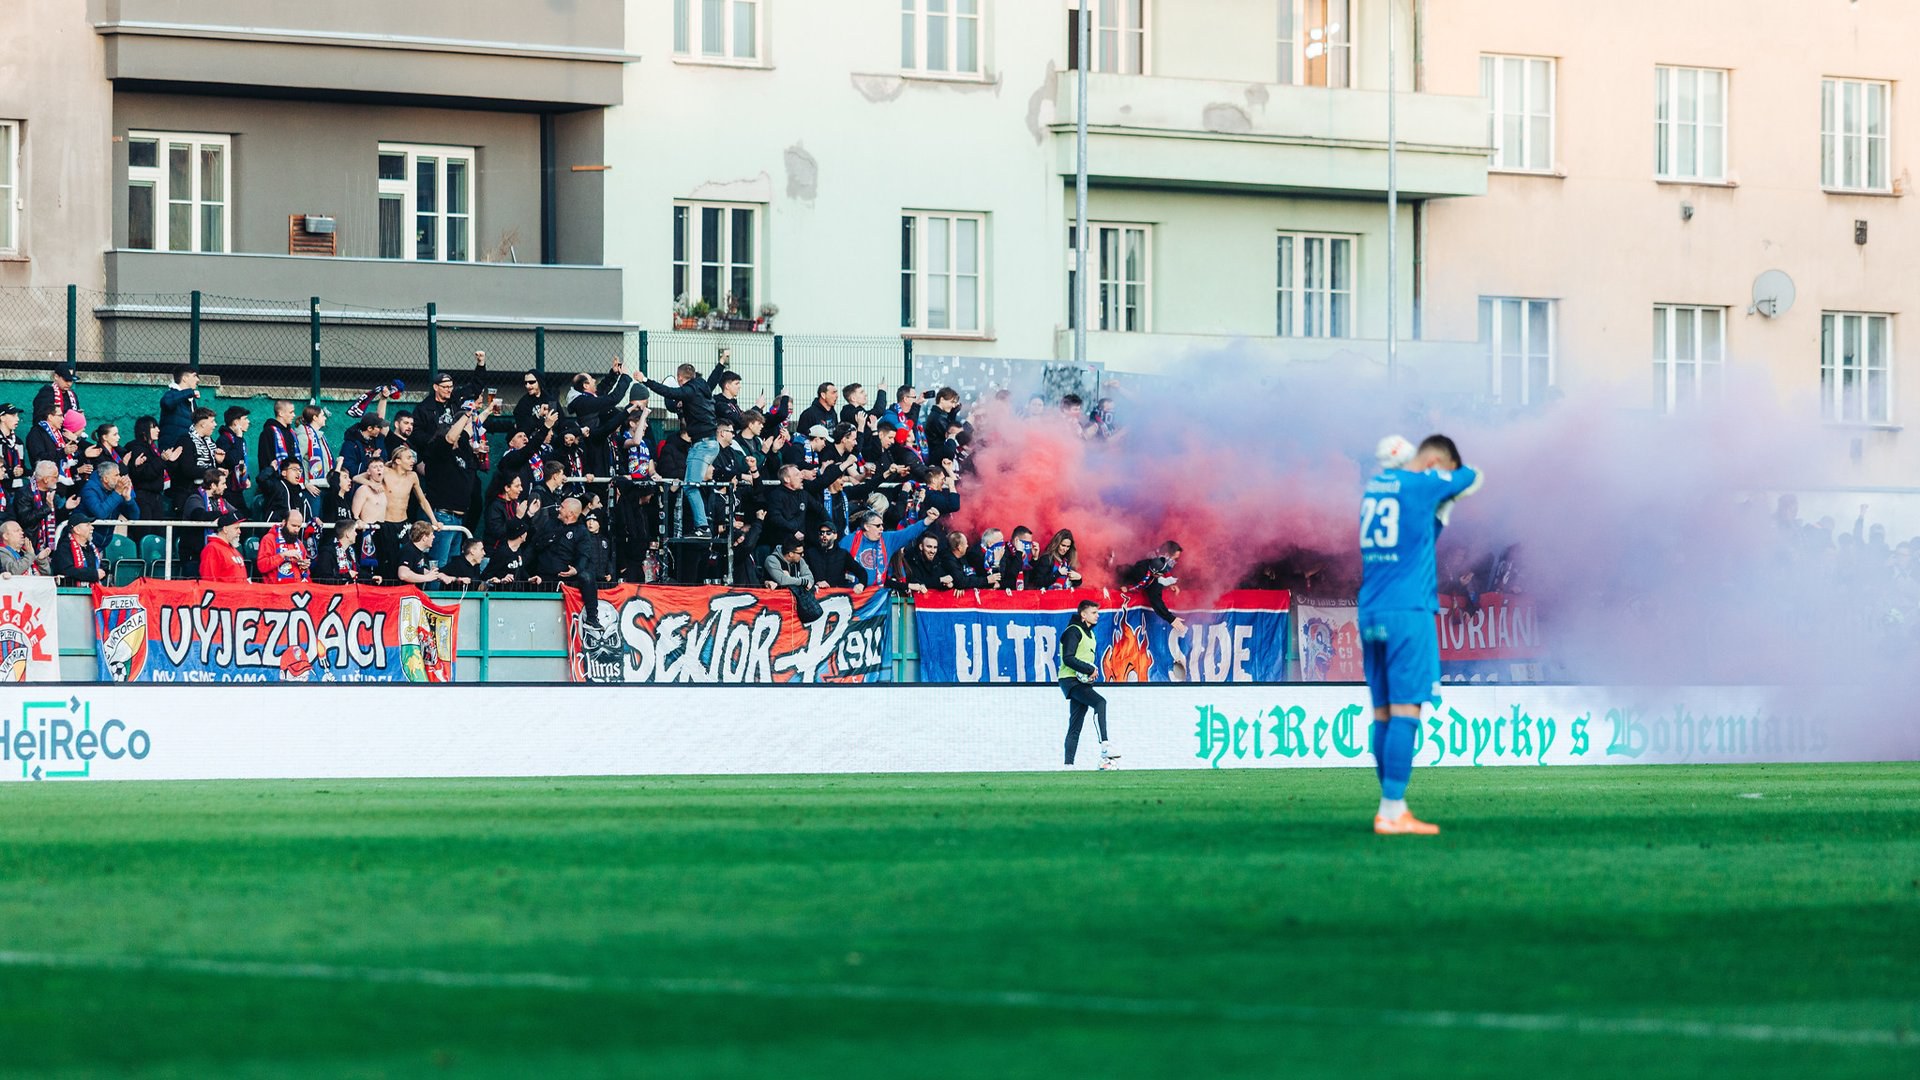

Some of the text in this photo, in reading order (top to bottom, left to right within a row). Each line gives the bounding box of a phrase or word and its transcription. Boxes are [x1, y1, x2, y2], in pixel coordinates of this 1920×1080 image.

[1360, 497, 1399, 547] 23
[160, 590, 387, 668] VÝJEZĎÁCI
[954, 620, 1253, 682] ULTR SIDE
[577, 652, 621, 679] Ultras
[1194, 695, 1830, 769] HeiReC ždycky s Bohemians
